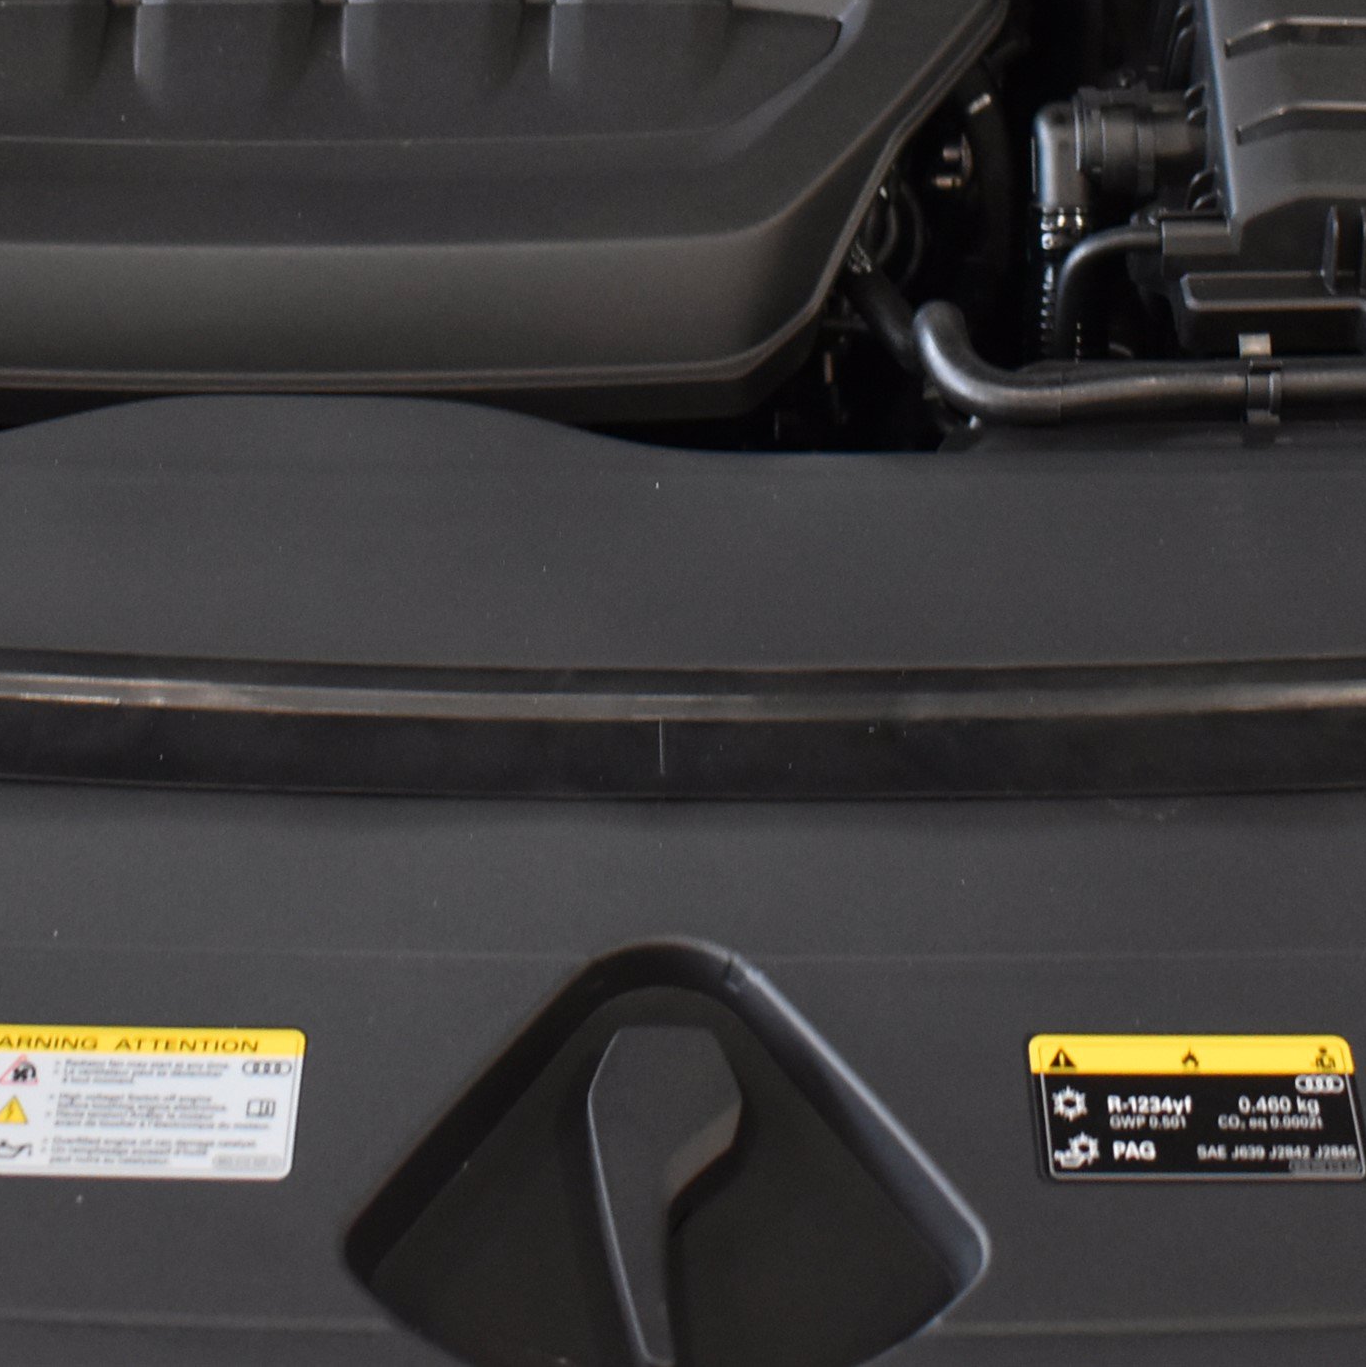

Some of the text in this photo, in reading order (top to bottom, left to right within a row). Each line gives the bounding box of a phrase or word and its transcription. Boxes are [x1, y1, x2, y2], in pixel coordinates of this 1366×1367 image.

[114, 1036, 259, 1053] ATTENTION
[1106, 1094, 1193, 1116] R-1234yf
[1296, 1094, 1321, 1117] kg
[1108, 1114, 1147, 1130] GWP
[1112, 1139, 1158, 1161] PAG
[1196, 1143, 1227, 1161] SAE
